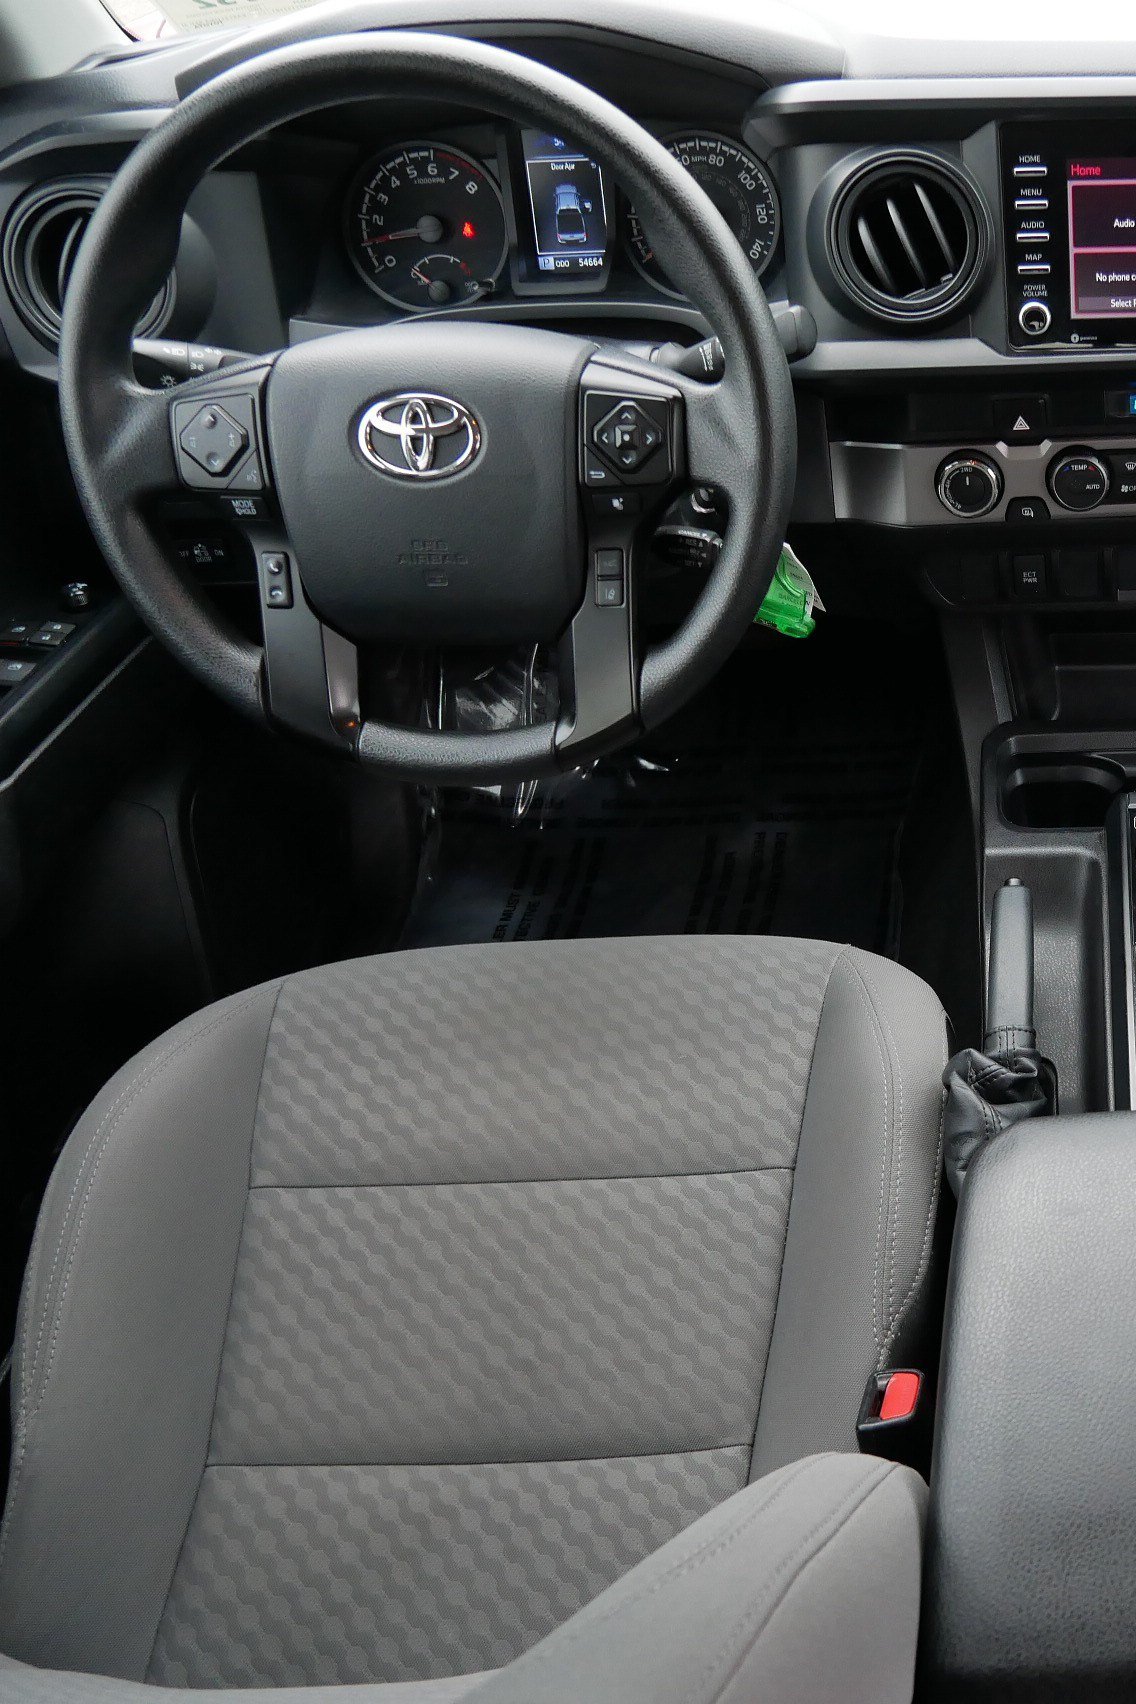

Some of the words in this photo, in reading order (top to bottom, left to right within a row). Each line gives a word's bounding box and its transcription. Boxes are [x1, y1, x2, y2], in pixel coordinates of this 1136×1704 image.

[708, 155, 725, 167] 80
[1019, 155, 1041, 163] HOME
[406, 166, 418, 178] 5
[427, 163, 438, 175] 6
[449, 167, 460, 180] 7
[1070, 164, 1101, 176] Home
[390, 176, 401, 189] 4
[738, 170, 756, 190] 100
[465, 181, 478, 194] 8
[1020, 188, 1042, 196] MENU
[377, 192, 389, 205] 3
[755, 203, 768, 224] 120
[372, 214, 384, 226] 2
[1020, 221, 1045, 229] AUDIO
[1113, 218, 1135, 228] Audio
[749, 238, 765, 260] 140
[384, 255, 397, 267] 0
[578, 257, 603, 267] 54664
[1025, 253, 1042, 261] MAP
[1095, 272, 1107, 282] No
[1108, 272, 1130, 283] phone
[1110, 298, 1132, 308] Select
[232, 499, 254, 508] MODE
